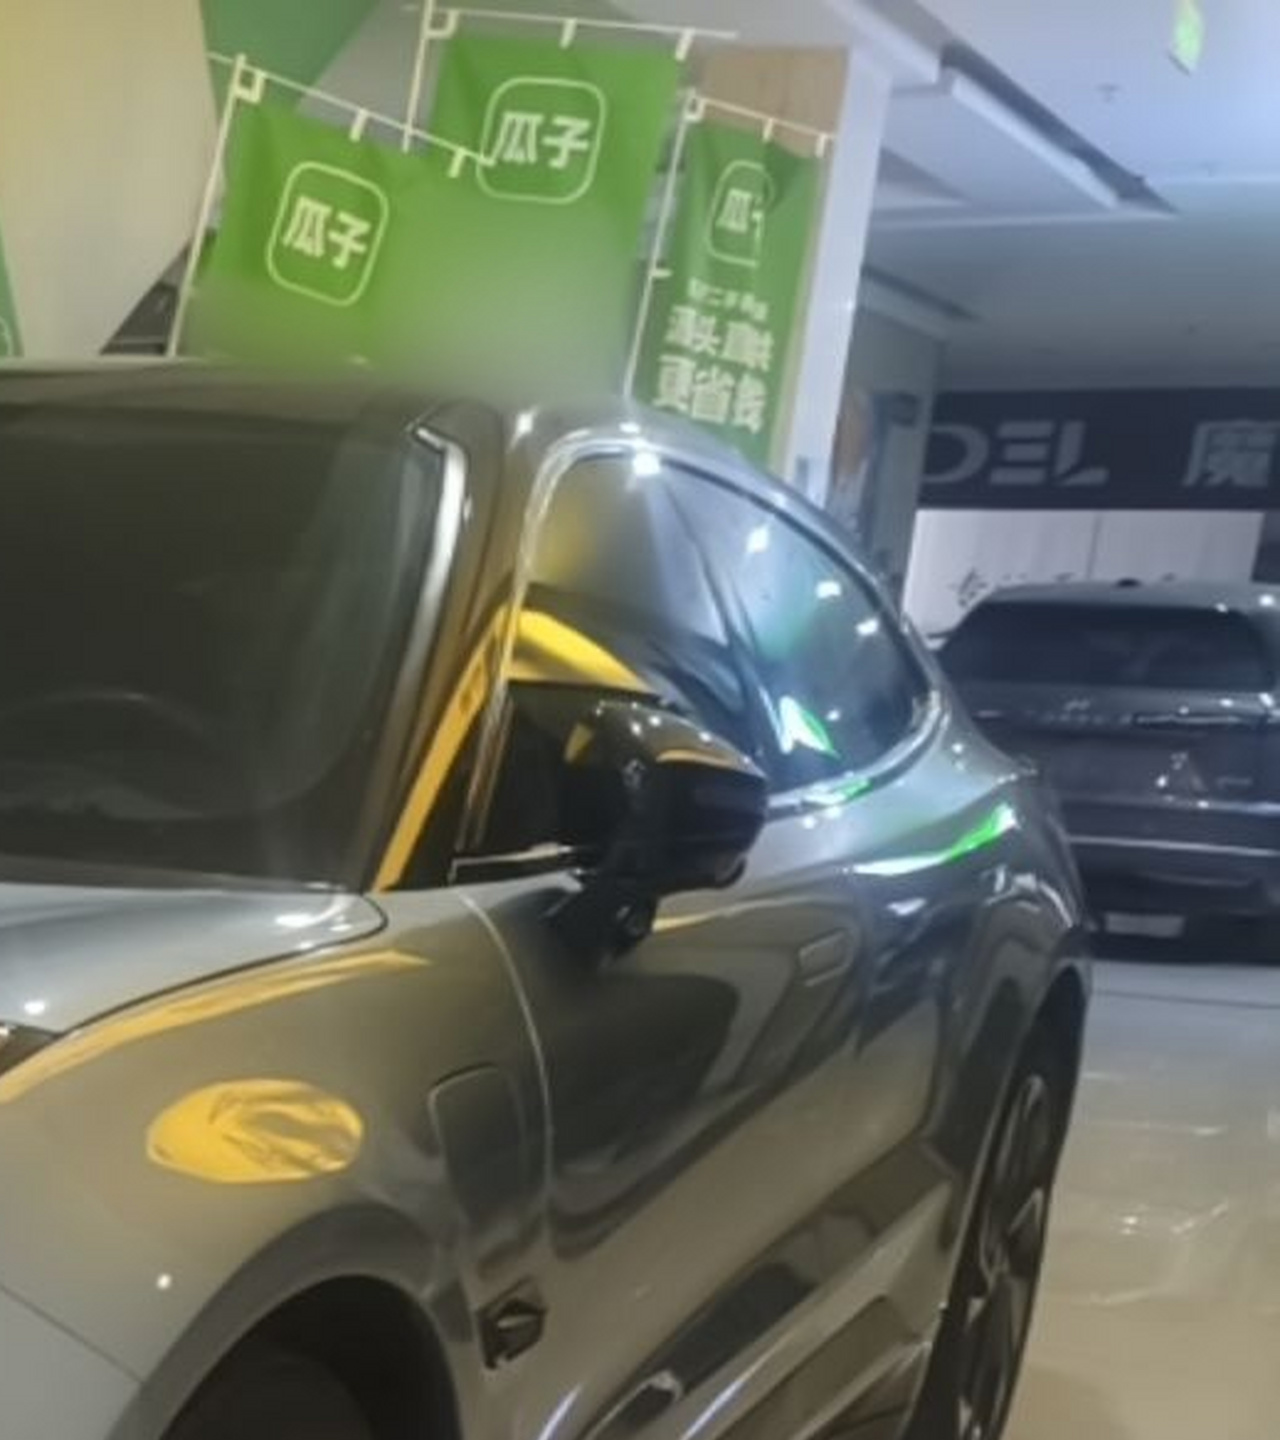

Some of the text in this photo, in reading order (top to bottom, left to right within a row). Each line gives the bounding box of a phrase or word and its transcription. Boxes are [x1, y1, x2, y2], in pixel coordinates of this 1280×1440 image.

[490, 111, 592, 169] 瓜子
[282, 195, 372, 270] 瓜子
[652, 352, 768, 434] 更省钱
